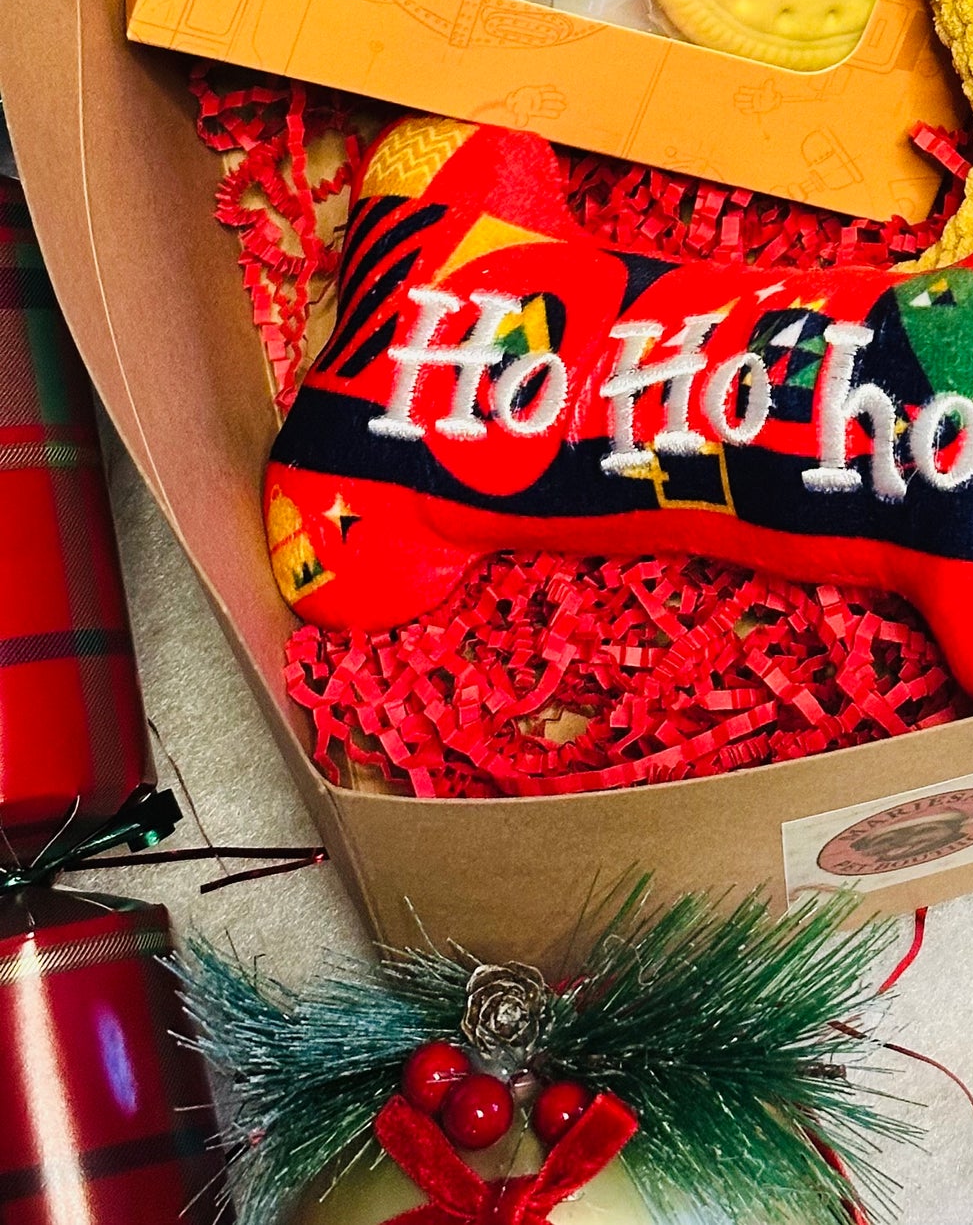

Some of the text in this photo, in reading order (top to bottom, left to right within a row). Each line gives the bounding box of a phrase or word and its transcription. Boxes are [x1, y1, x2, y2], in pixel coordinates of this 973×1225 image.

[367, 288, 568, 442] Ho
[600, 314, 773, 475] Ho
[833, 860, 868, 872] PET
